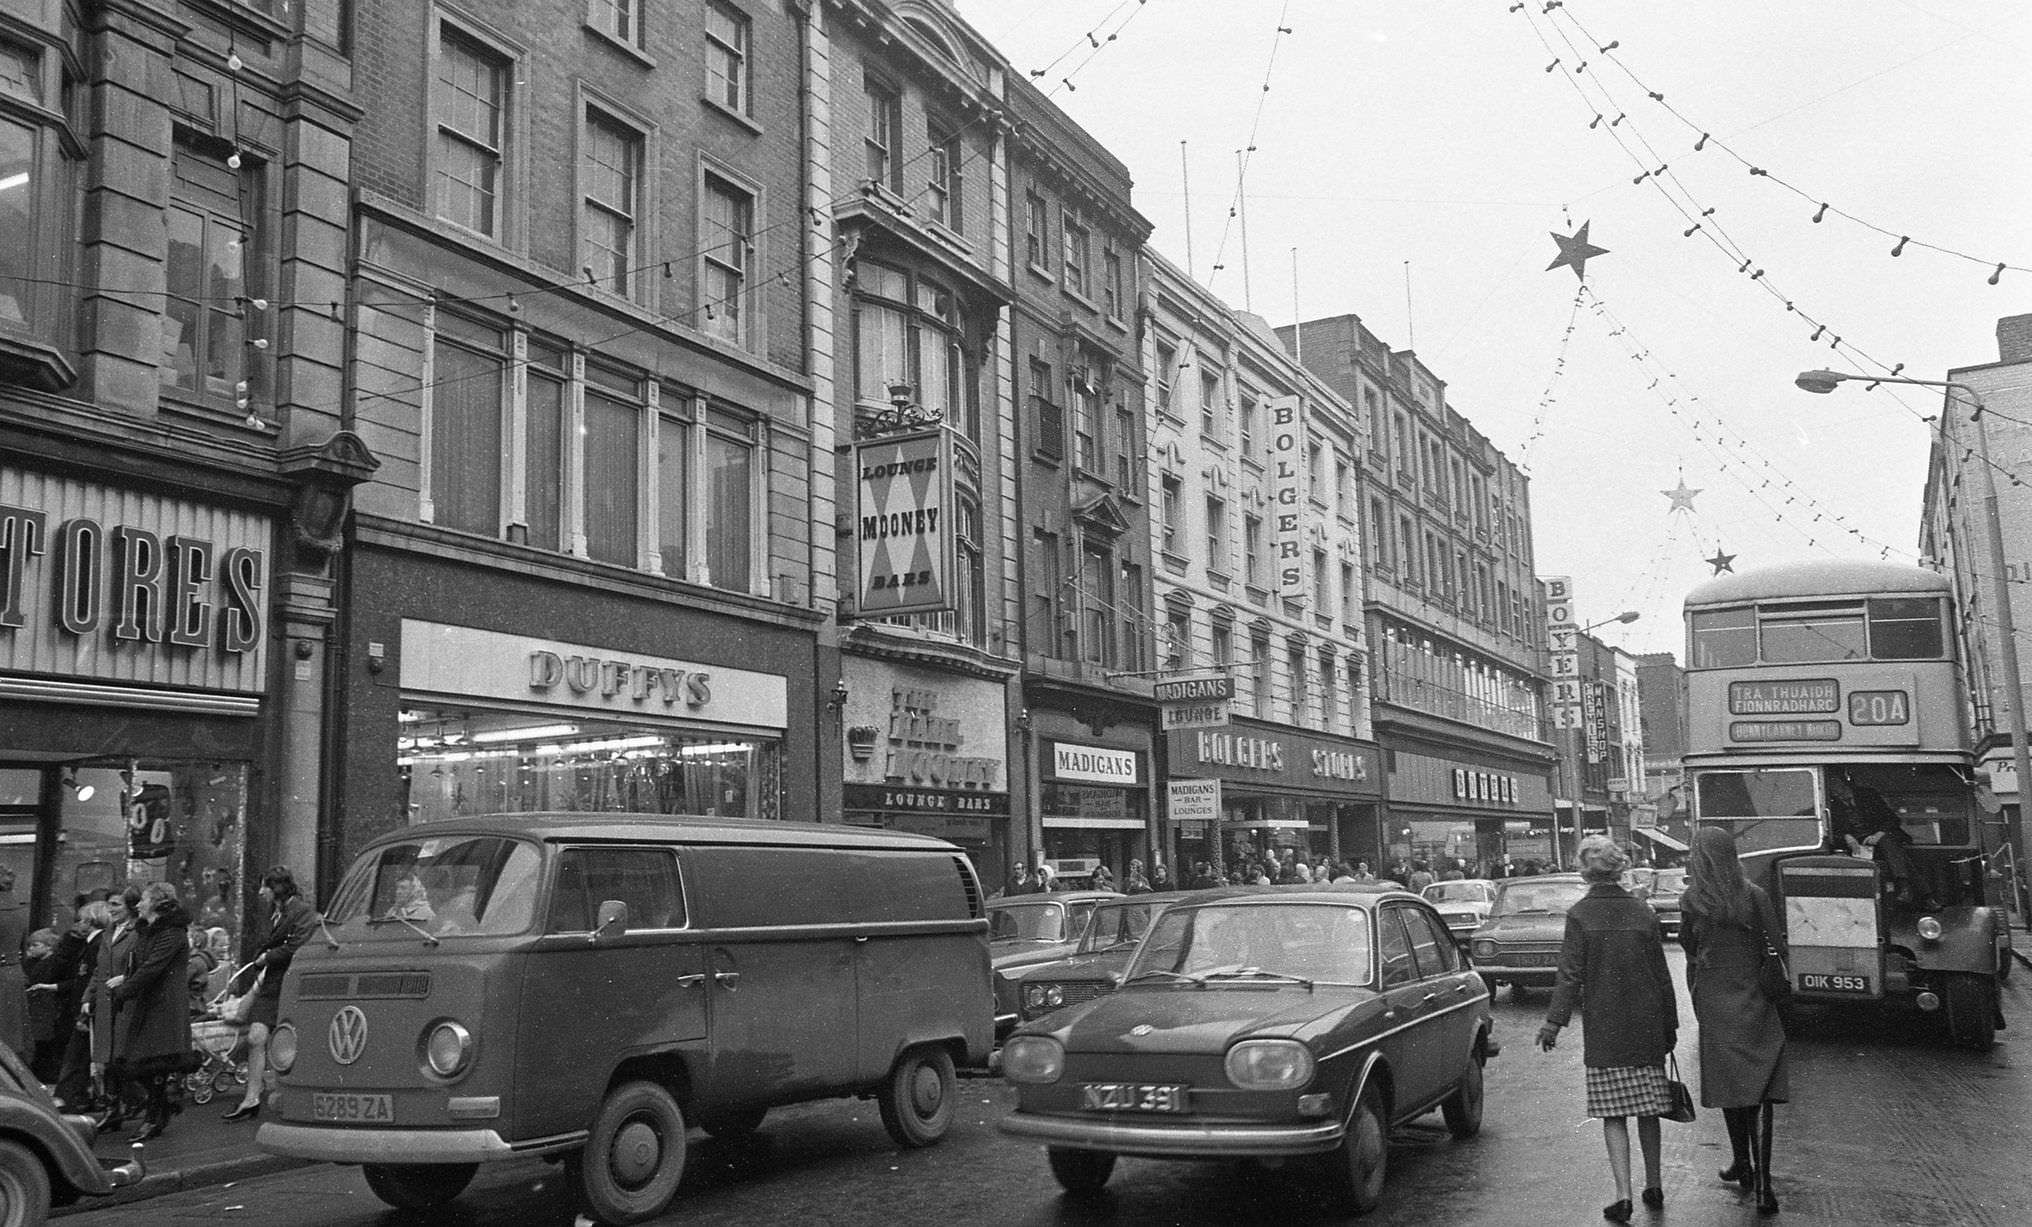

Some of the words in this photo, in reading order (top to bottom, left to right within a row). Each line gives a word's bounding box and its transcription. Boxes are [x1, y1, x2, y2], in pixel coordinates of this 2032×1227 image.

[862, 457, 937, 481] LOUNGE
[1274, 407, 1300, 587] BOLGERS
[862, 507, 938, 541] MOONEY
[871, 570, 931, 591] BARS
[1548, 580, 1576, 728] BOYERS
[528, 649, 712, 708] DUFFYS
[1156, 679, 1227, 701] MADIGANS
[1772, 685, 1833, 699] THUAIDH
[1167, 706, 1223, 725] LOUNGE
[1853, 694, 1905, 722] 20A
[1198, 731, 1284, 771] BOLGERS
[1057, 749, 1133, 777] MADIGANS
[1171, 784, 1215, 795] MADIGANS
[1184, 796, 1202, 804] BAR
[885, 793, 945, 808] LOUNGE
[957, 797, 991, 810] BARS
[1174, 806, 1213, 816] LOUNGES
[1832, 975, 1865, 990] 953
[362, 1096, 389, 1119] ZA
